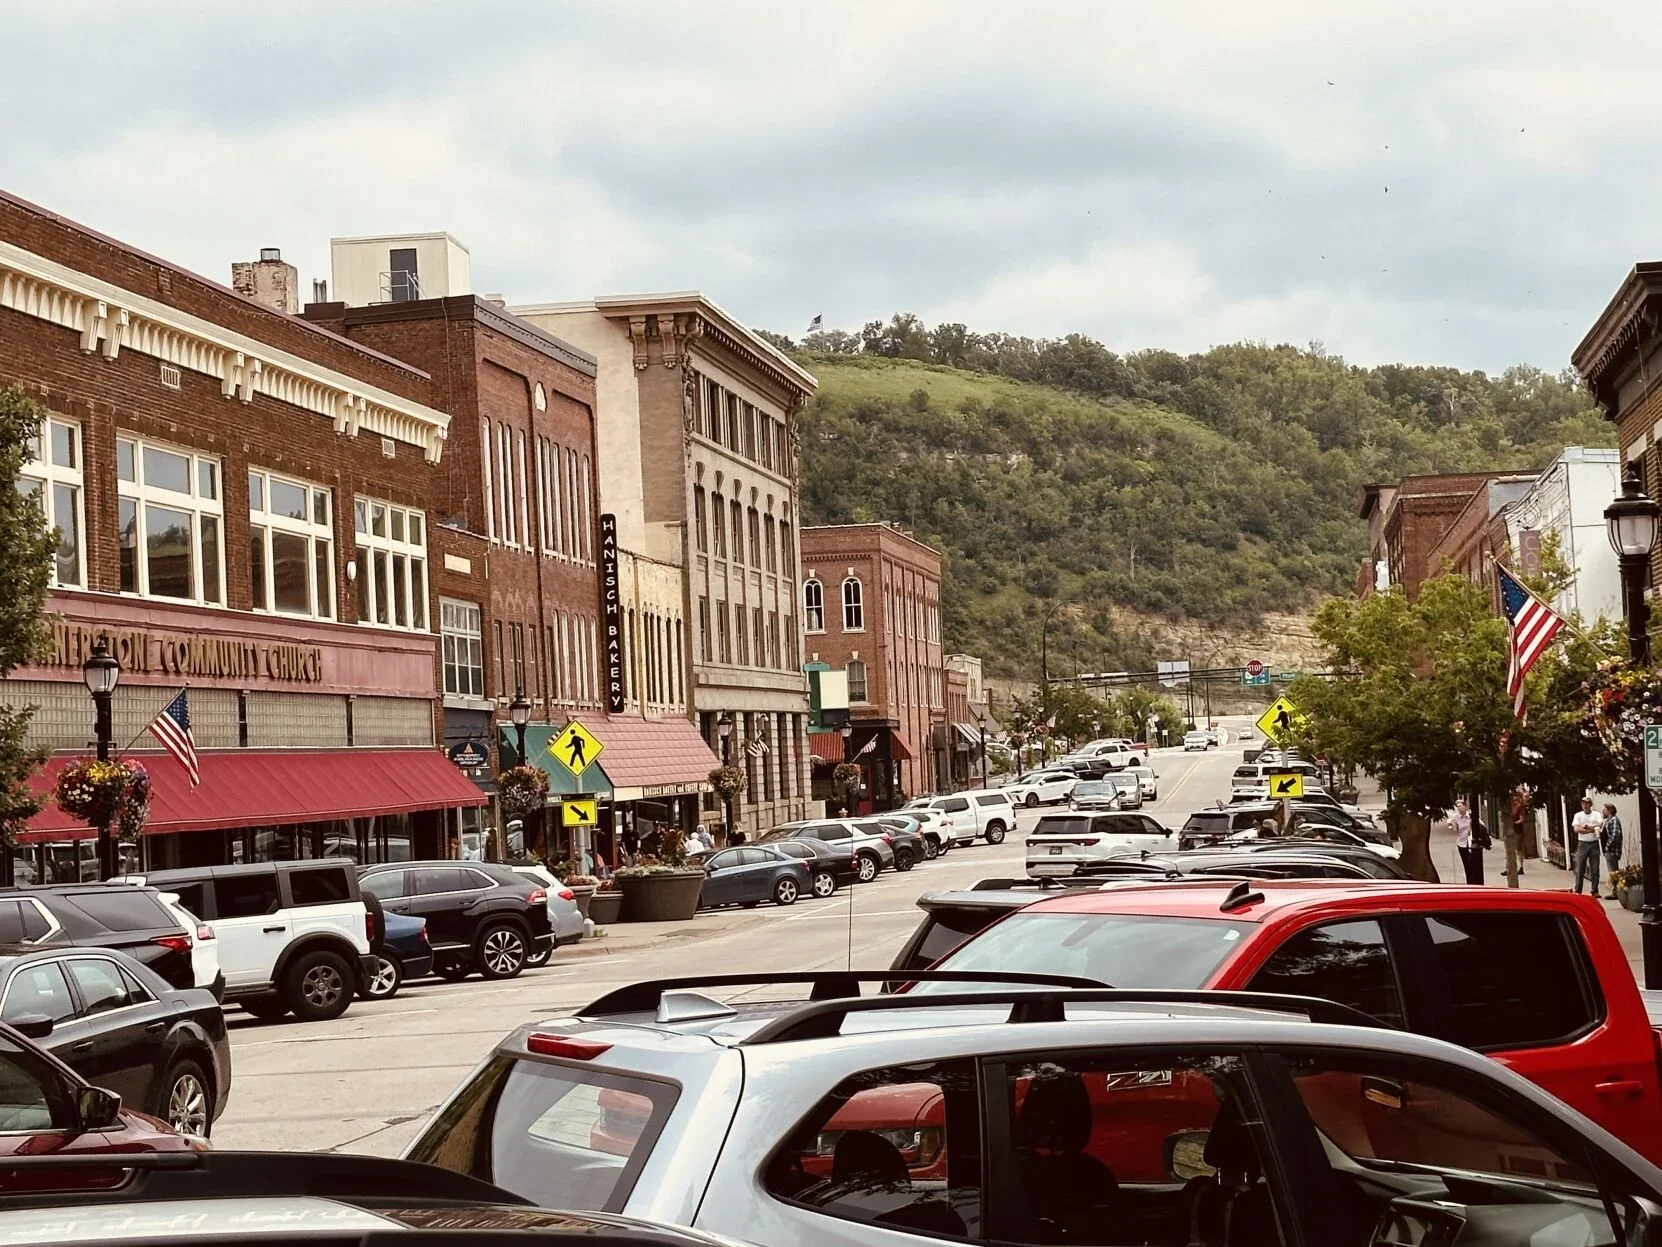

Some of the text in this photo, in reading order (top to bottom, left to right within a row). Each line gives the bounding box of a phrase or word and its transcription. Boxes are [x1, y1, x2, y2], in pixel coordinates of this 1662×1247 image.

[603, 520, 621, 707] HANISCH BAKERY
[162, 634, 260, 676] COMMUNITY
[267, 644, 323, 681] CHURCH
[1647, 730, 1658, 746] 2
